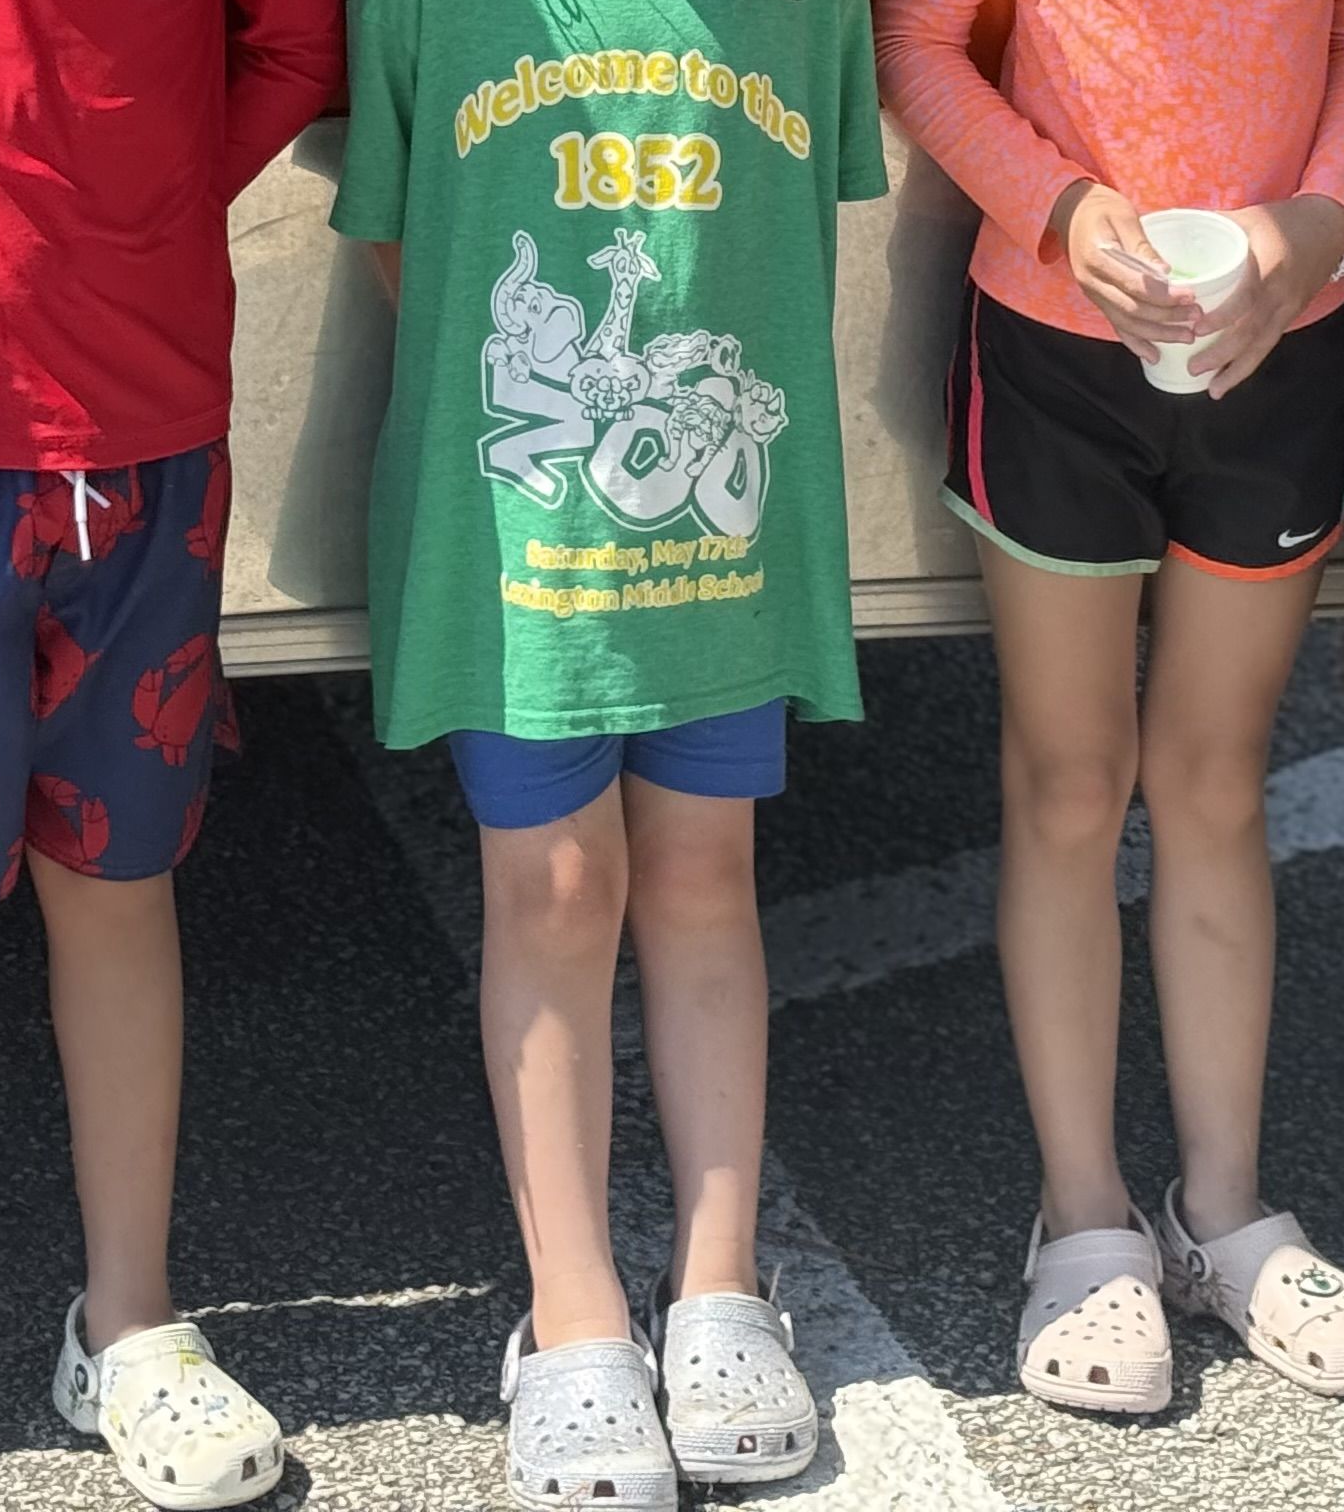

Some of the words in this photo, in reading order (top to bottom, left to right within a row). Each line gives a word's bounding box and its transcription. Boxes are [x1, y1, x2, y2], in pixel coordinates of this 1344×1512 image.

[455, 48, 679, 159] Welcome
[680, 48, 738, 109] to
[740, 72, 811, 161] the
[549, 131, 723, 211] 1852
[526, 539, 649, 576] Saturday,
[652, 540, 698, 570] May
[698, 535, 748, 561] 17th
